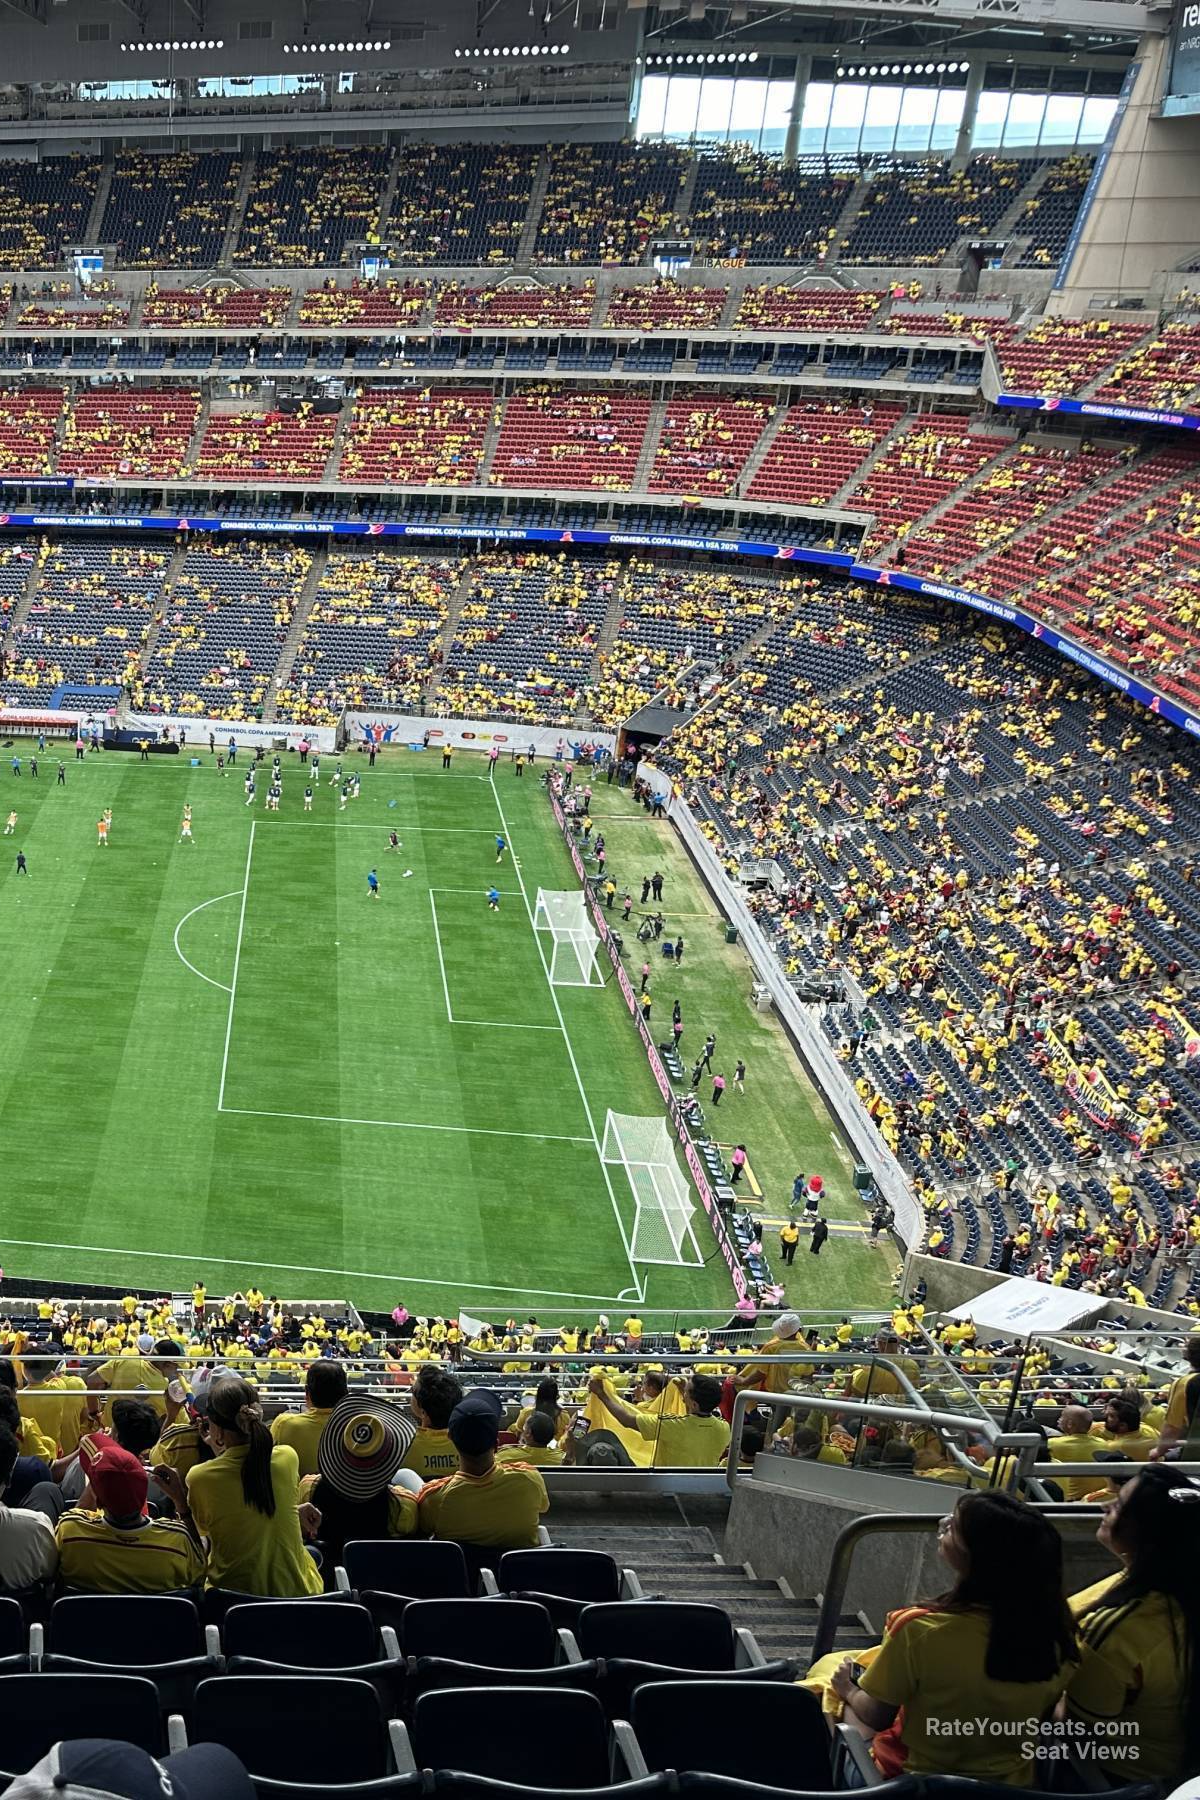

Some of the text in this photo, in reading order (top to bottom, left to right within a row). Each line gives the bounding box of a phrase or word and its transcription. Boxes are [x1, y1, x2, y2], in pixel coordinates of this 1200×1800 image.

[1183, 4, 1200, 27] re
[405, 527, 444, 535] CONMEBOL
[444, 528, 462, 536] COPA
[462, 529, 494, 537] AMERICA
[509, 530, 527, 538] 2024
[609, 535, 739, 551] CONMEBOL COPA AMERICA USA 2024
[215, 726, 247, 734] CONMEBOL
